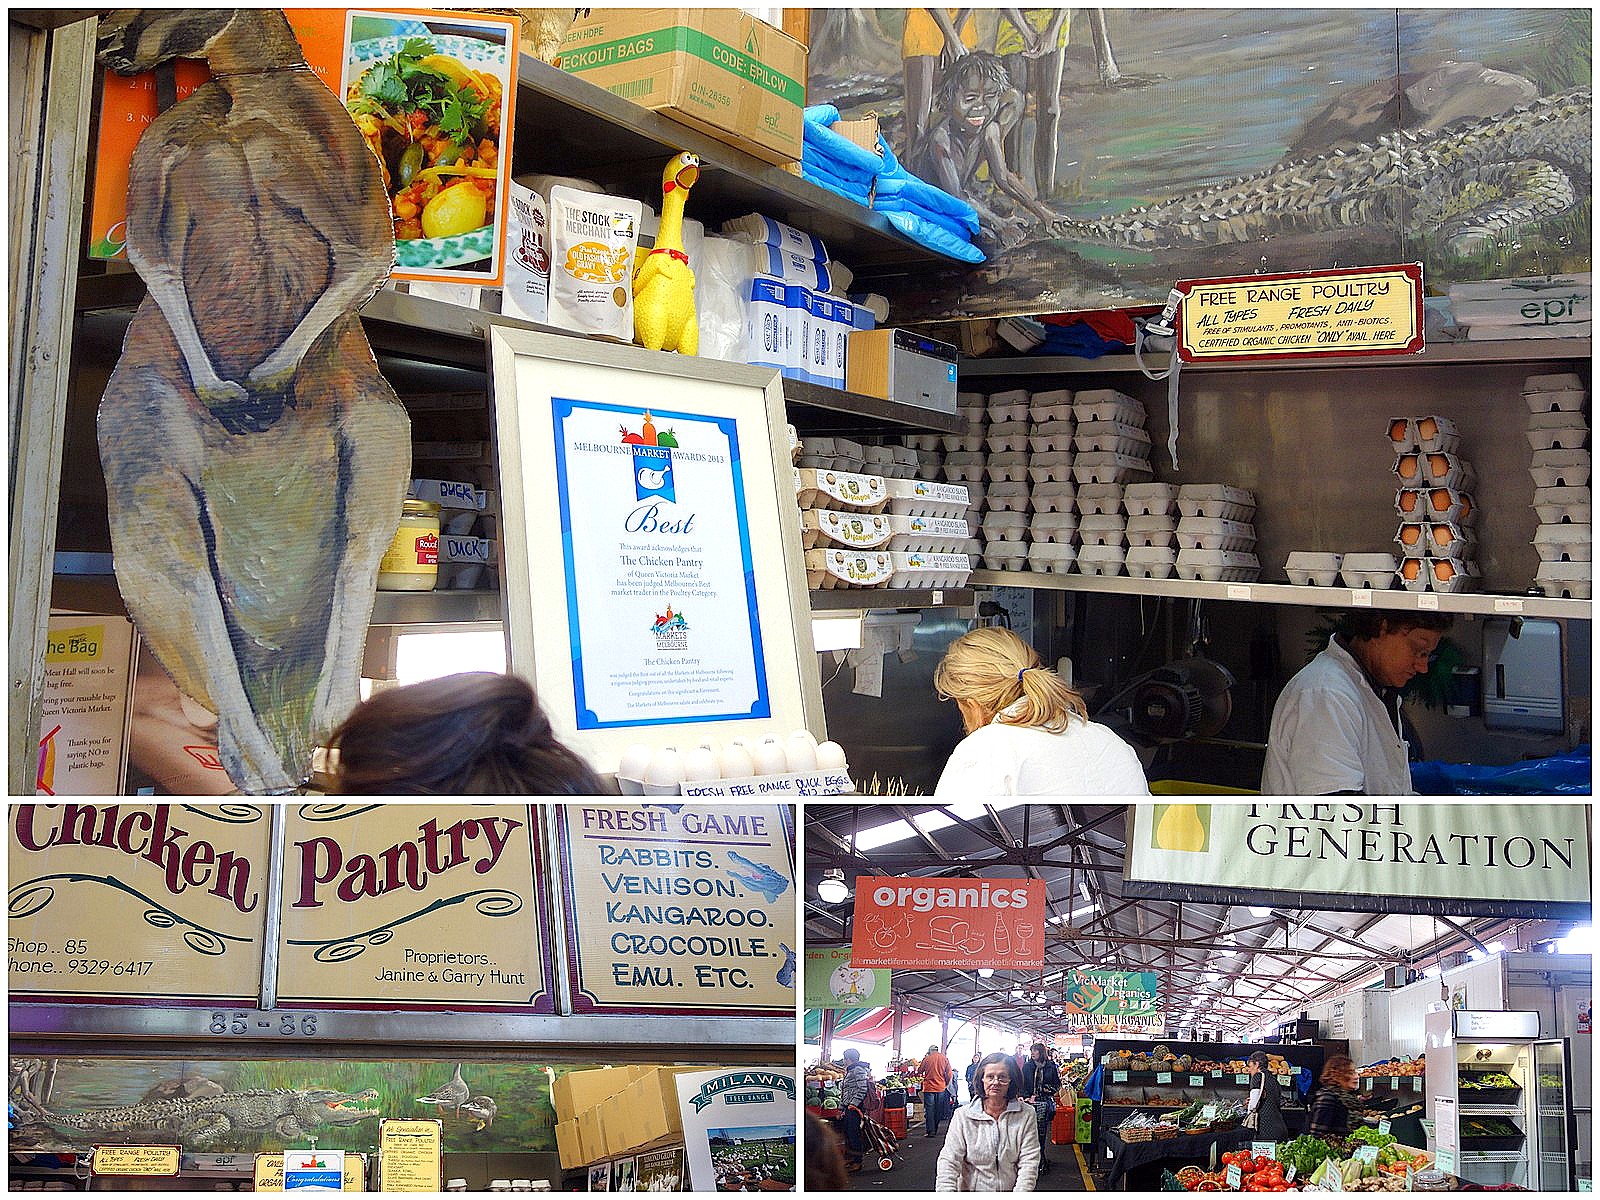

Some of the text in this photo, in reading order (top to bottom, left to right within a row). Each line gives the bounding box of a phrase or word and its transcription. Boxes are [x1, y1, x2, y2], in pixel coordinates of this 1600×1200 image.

[563, 27, 604, 43] REEN HDPE
[560, 38, 654, 70] ECKOUT BAGS
[712, 46, 788, 92] CODE: EPILCW
[565, 206, 580, 222] THE
[581, 210, 610, 228] STOCK
[565, 220, 611, 239] MERCHANT
[1200, 281, 1390, 306] FREE RANGE POULTRY
[1196, 299, 1375, 328] ALL TYPES FRESH DAILY
[1198, 338, 1240, 348] CERTIFIED
[1242, 336, 1276, 347] ORGANIC
[1277, 334, 1312, 345] CHICKEN
[1372, 329, 1397, 341] HERE
[1202, 327, 1221, 336] FREE
[574, 442, 725, 463] MELBOURNE MARKET AWARDS 2013
[440, 482, 474, 501] DUCK
[624, 501, 696, 534] Best
[448, 540, 483, 560] DUCK
[619, 542, 632, 550] This
[652, 544, 690, 553] acknowledges
[691, 545, 702, 553] that
[620, 555, 703, 570] The Chicken Pantry
[616, 578, 711, 588] has been judged Melbourne's Best
[628, 570, 699, 579] of Queen Victoria Market
[611, 588, 633, 596] market
[659, 588, 669, 596] the
[670, 589, 690, 598] Poultry
[655, 631, 687, 640] MARKETS
[46, 639, 66, 654] he
[70, 640, 98, 656] Bag
[62, 668, 77, 676] Hall
[78, 667, 90, 675] will
[107, 666, 115, 674] be
[643, 657, 700, 667] The Chicken Pantry
[47, 680, 74, 690] bag free.
[60, 696, 75, 704] your
[76, 694, 102, 702] reusable
[103, 693, 116, 701] bags
[61, 704, 112, 714] Victoria Market.
[67, 738, 87, 747] Thank
[88, 740, 101, 748] you
[67, 750, 87, 760] saying
[88, 749, 101, 757] NO
[68, 761, 89, 772] plastic
[730, 785, 755, 796] FREE
[758, 780, 792, 793] RANGE
[795, 777, 821, 790] DUCK
[825, 776, 850, 786] EGGS
[582, 808, 768, 837] FRESH GAME
[1246, 824, 1575, 870] GENERATION
[15, 804, 523, 913] Chicken Pantry
[598, 845, 719, 869] RABBITS.
[601, 872, 744, 898] VENISON.
[873, 883, 1028, 912] organics
[606, 901, 774, 928] KANGAROO.
[64, 939, 88, 955] 85
[610, 932, 777, 958] CROCODILE.
[831, 950, 850, 960] Org
[8, 957, 153, 976] hone.. 9329-6417
[612, 963, 754, 989] EMU. ETC.
[374, 967, 525, 986] Janine & Garry Hunt
[1072, 973, 1128, 987] VicMarket
[1103, 985, 1151, 1000] Organics
[1071, 1013, 1163, 1027] MARKET ORGANICS
[706, 1074, 789, 1094] MILAWA
[286, 1174, 340, 1187] Congratulations
